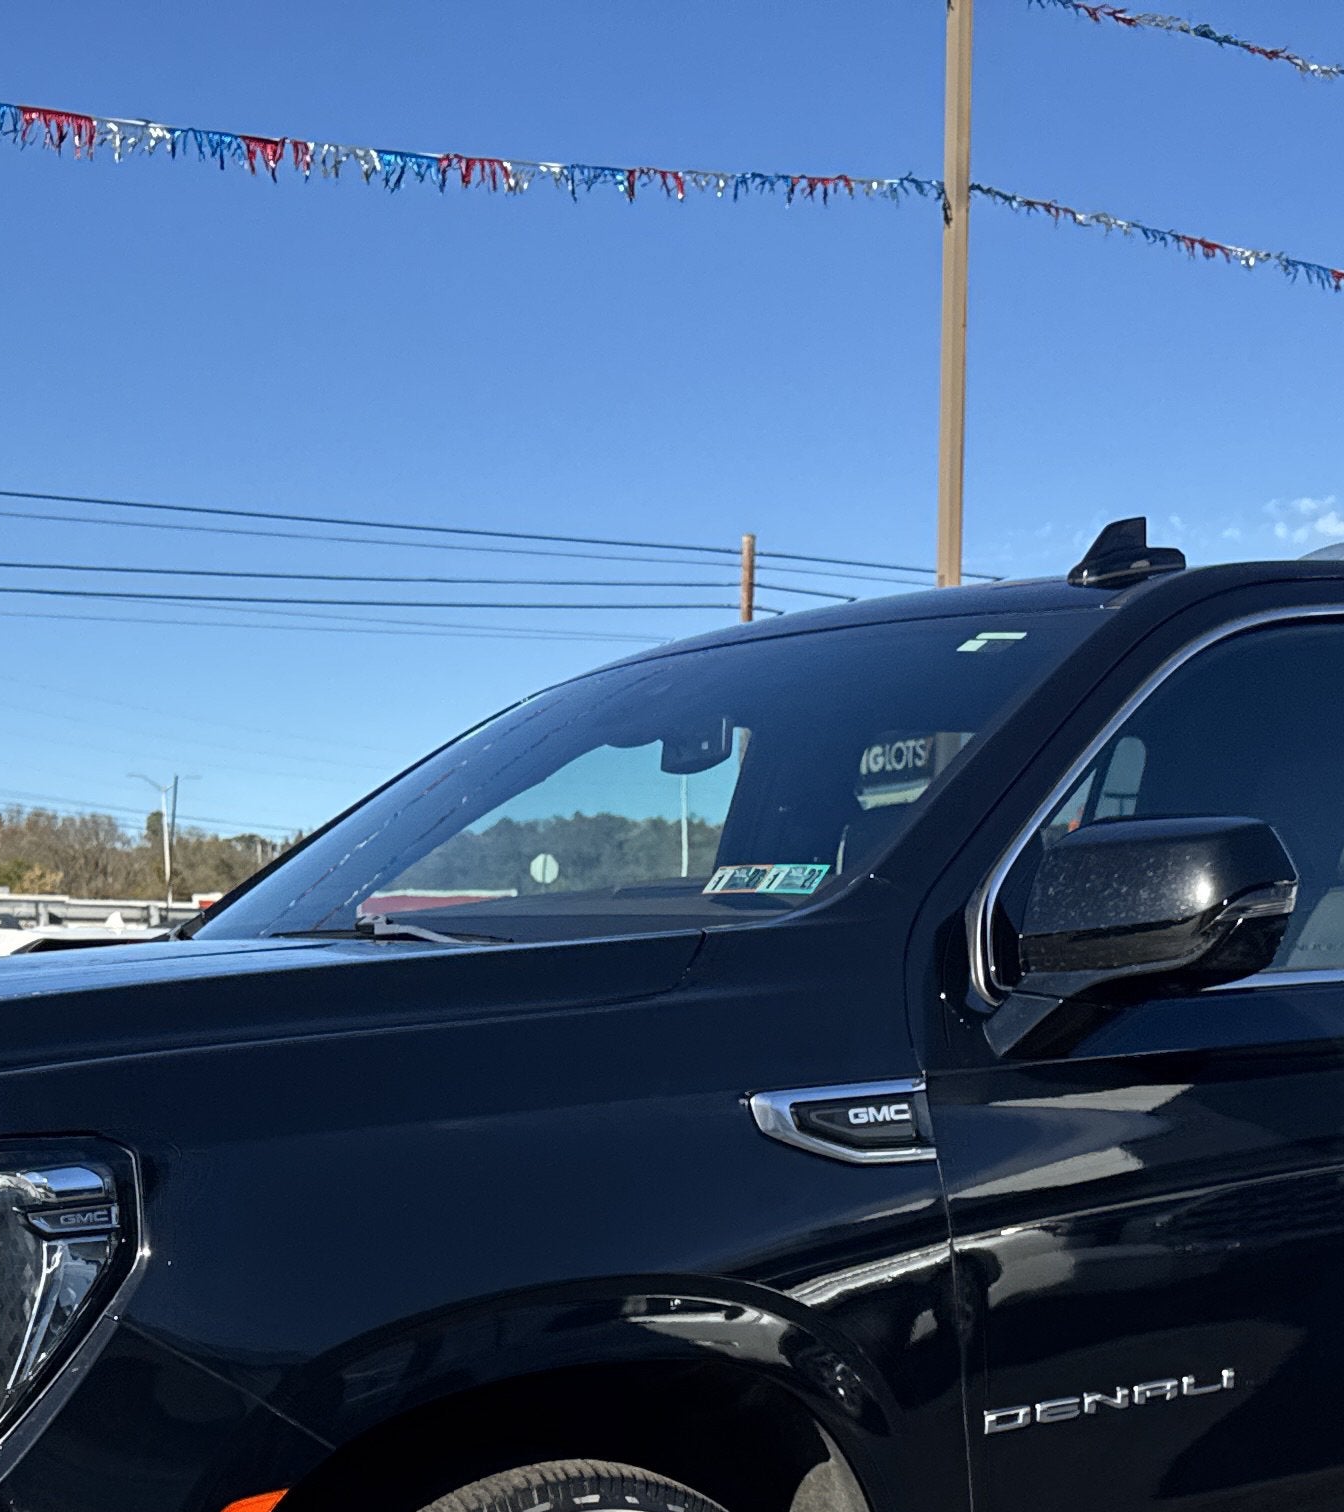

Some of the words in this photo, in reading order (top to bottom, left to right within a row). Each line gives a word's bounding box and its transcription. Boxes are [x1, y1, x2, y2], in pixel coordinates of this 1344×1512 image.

[848, 1103, 912, 1125] GMC
[60, 1209, 109, 1225] GMC
[983, 1368, 1236, 1435] DENALI
